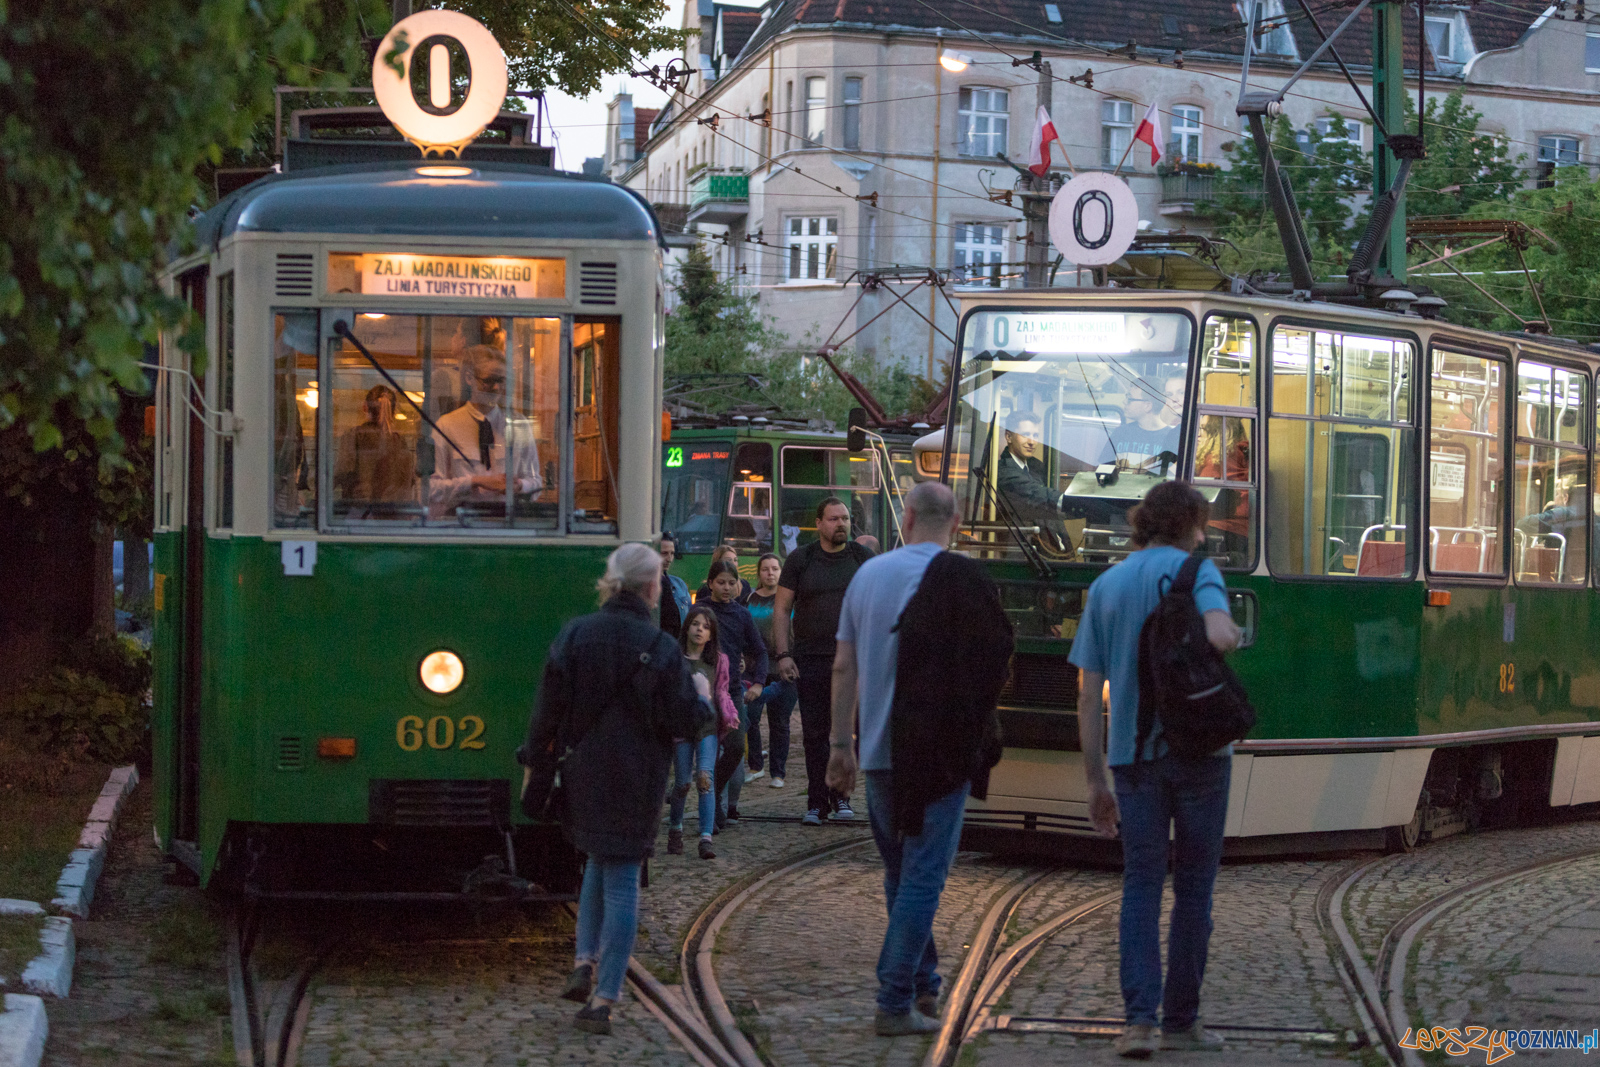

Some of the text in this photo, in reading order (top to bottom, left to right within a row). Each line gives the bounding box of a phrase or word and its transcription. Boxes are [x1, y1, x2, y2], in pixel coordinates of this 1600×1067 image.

[408, 33, 472, 117] 0
[1072, 189, 1114, 250] 0
[386, 278, 517, 298] LINIA TURYSTYCZNA
[666, 447, 683, 467] 23
[712, 451, 730, 459] TRASY
[1117, 441, 1129, 453] ON
[1132, 441, 1151, 454] THE
[294, 546, 304, 568] 1
[1499, 662, 1515, 693] 82
[396, 715, 486, 751] 602
